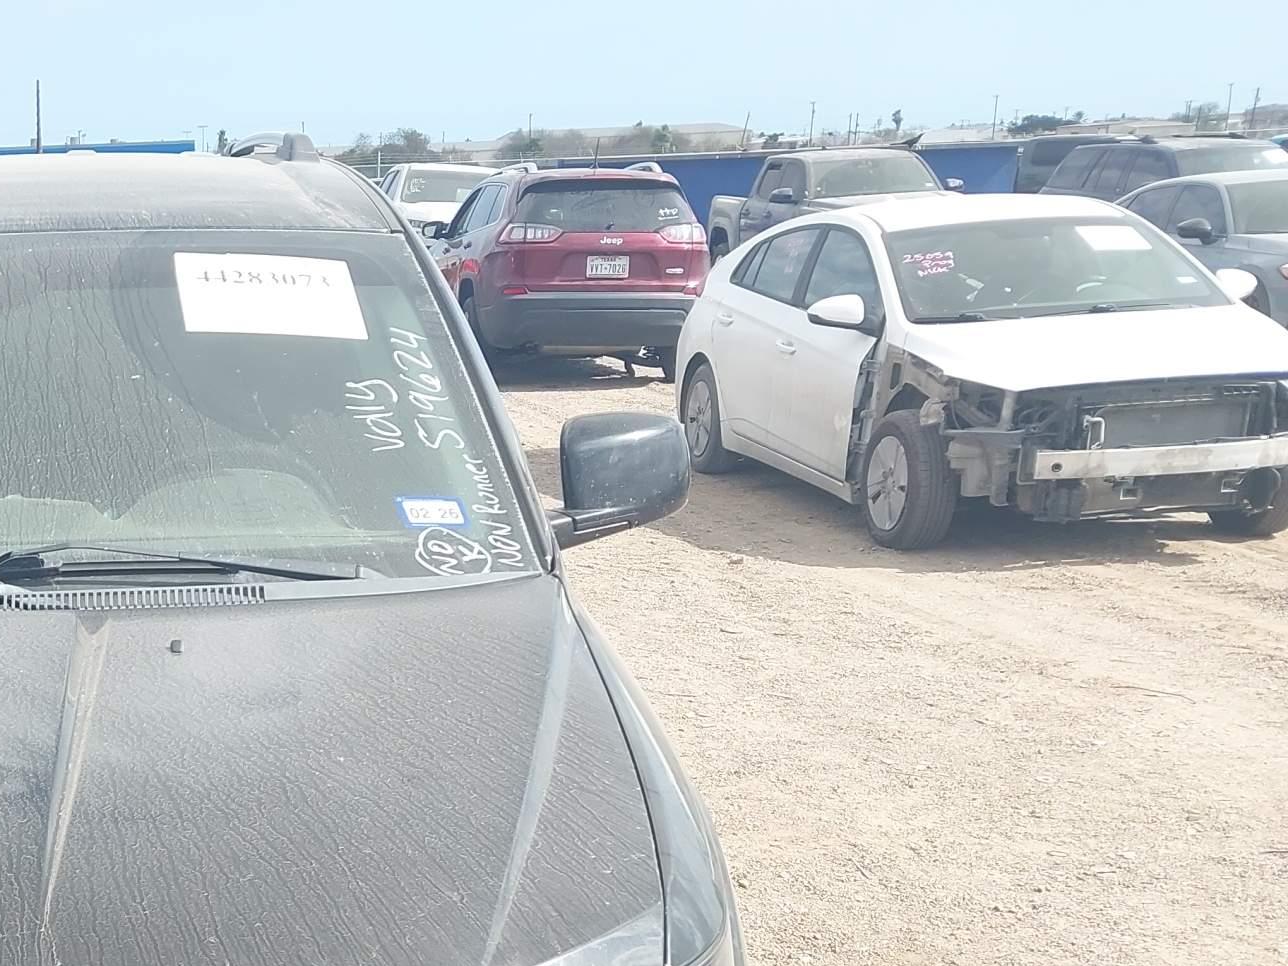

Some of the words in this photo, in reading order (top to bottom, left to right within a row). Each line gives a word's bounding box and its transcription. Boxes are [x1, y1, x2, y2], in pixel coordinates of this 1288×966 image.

[600, 236, 623, 245] Jeep
[389, 327, 465, 449] 519624
[409, 507, 431, 519] 02
